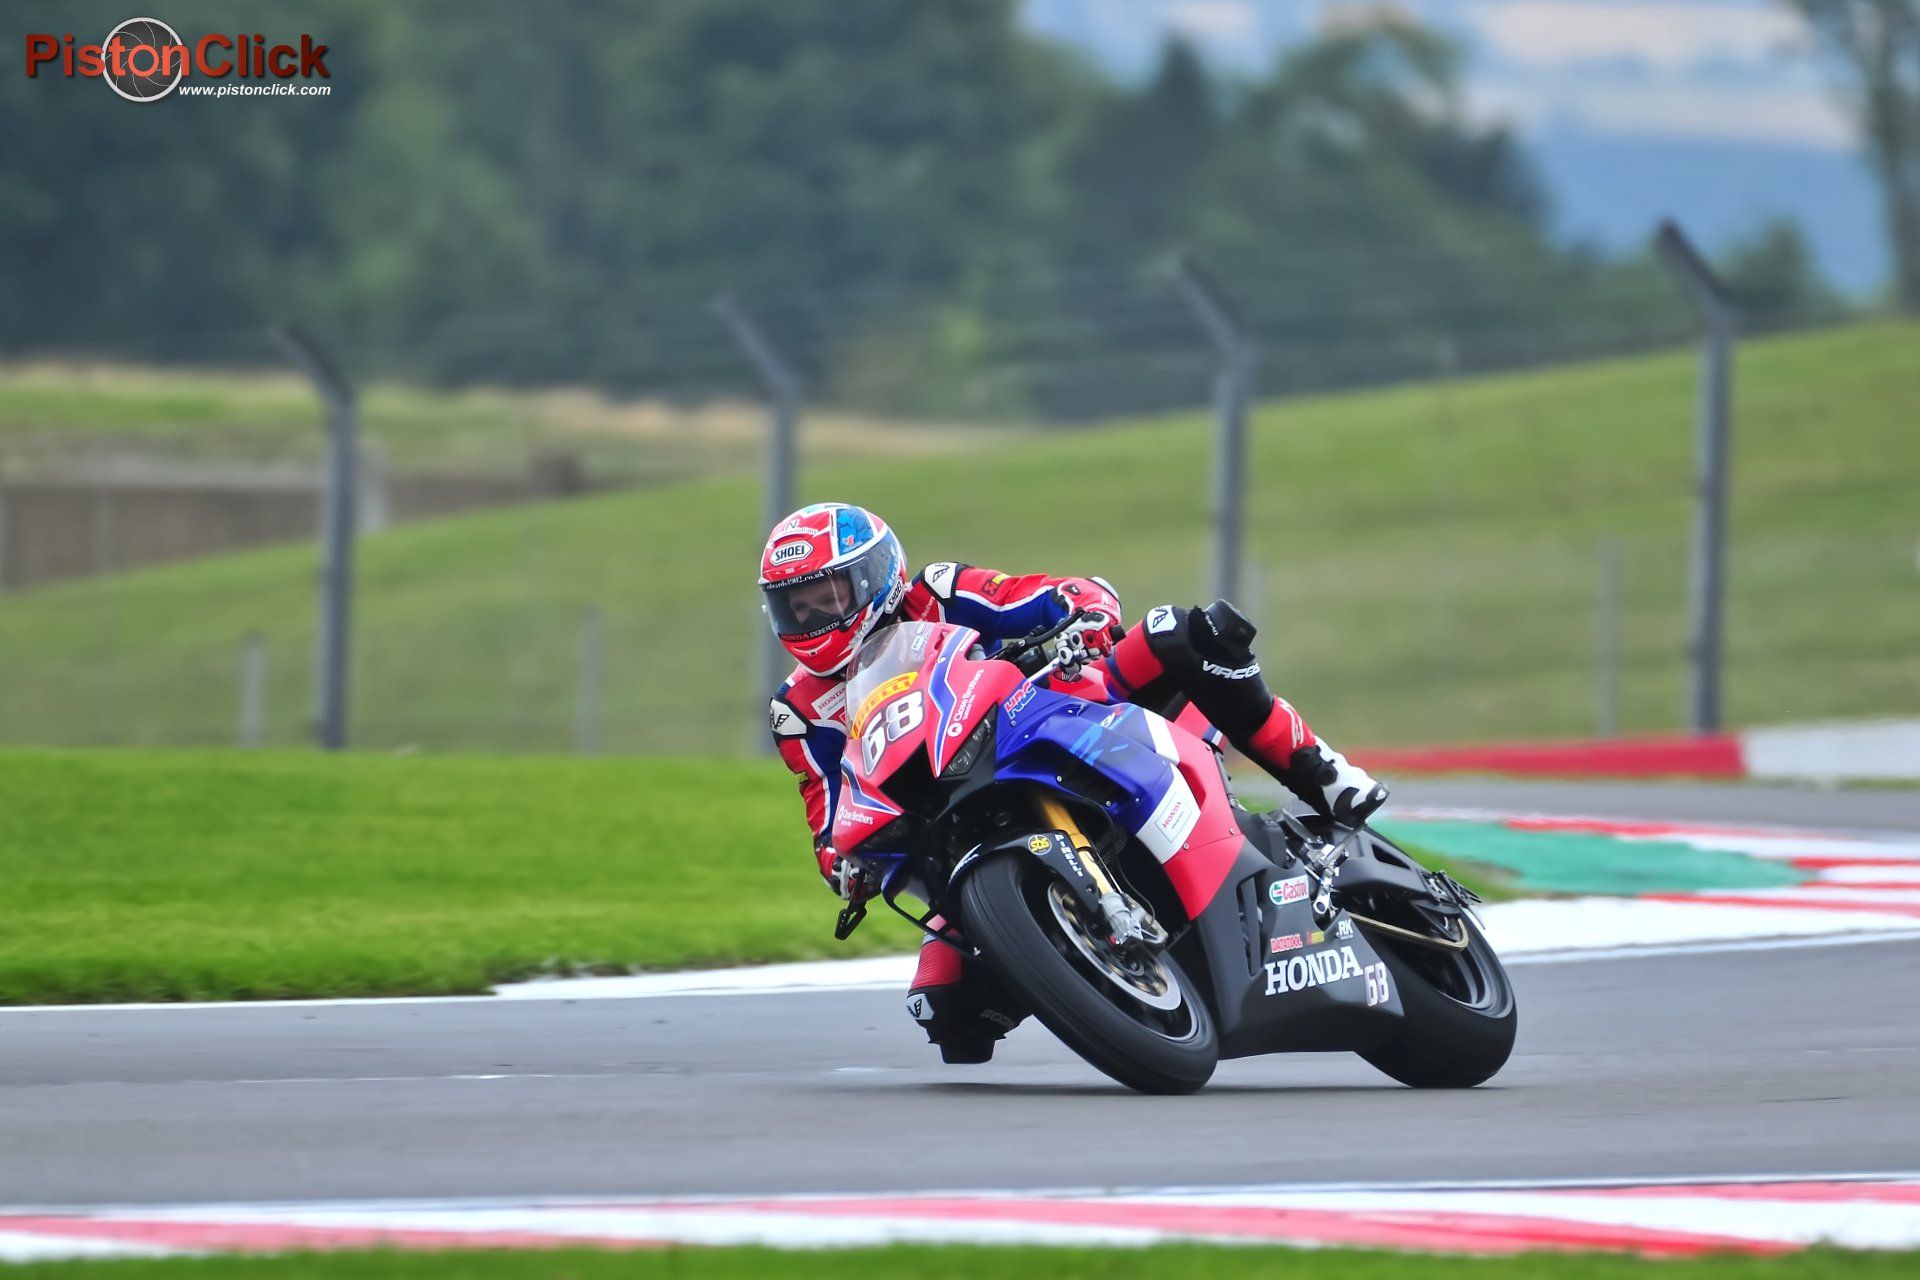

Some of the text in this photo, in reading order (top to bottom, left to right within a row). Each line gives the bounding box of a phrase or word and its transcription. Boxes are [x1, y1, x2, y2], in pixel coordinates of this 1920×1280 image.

[775, 543, 805, 561] SHOEI
[1003, 680, 1037, 720] HRC
[861, 690, 925, 778] 68
[1264, 945, 1363, 997] HONDA
[1364, 961, 1390, 1007] 68
